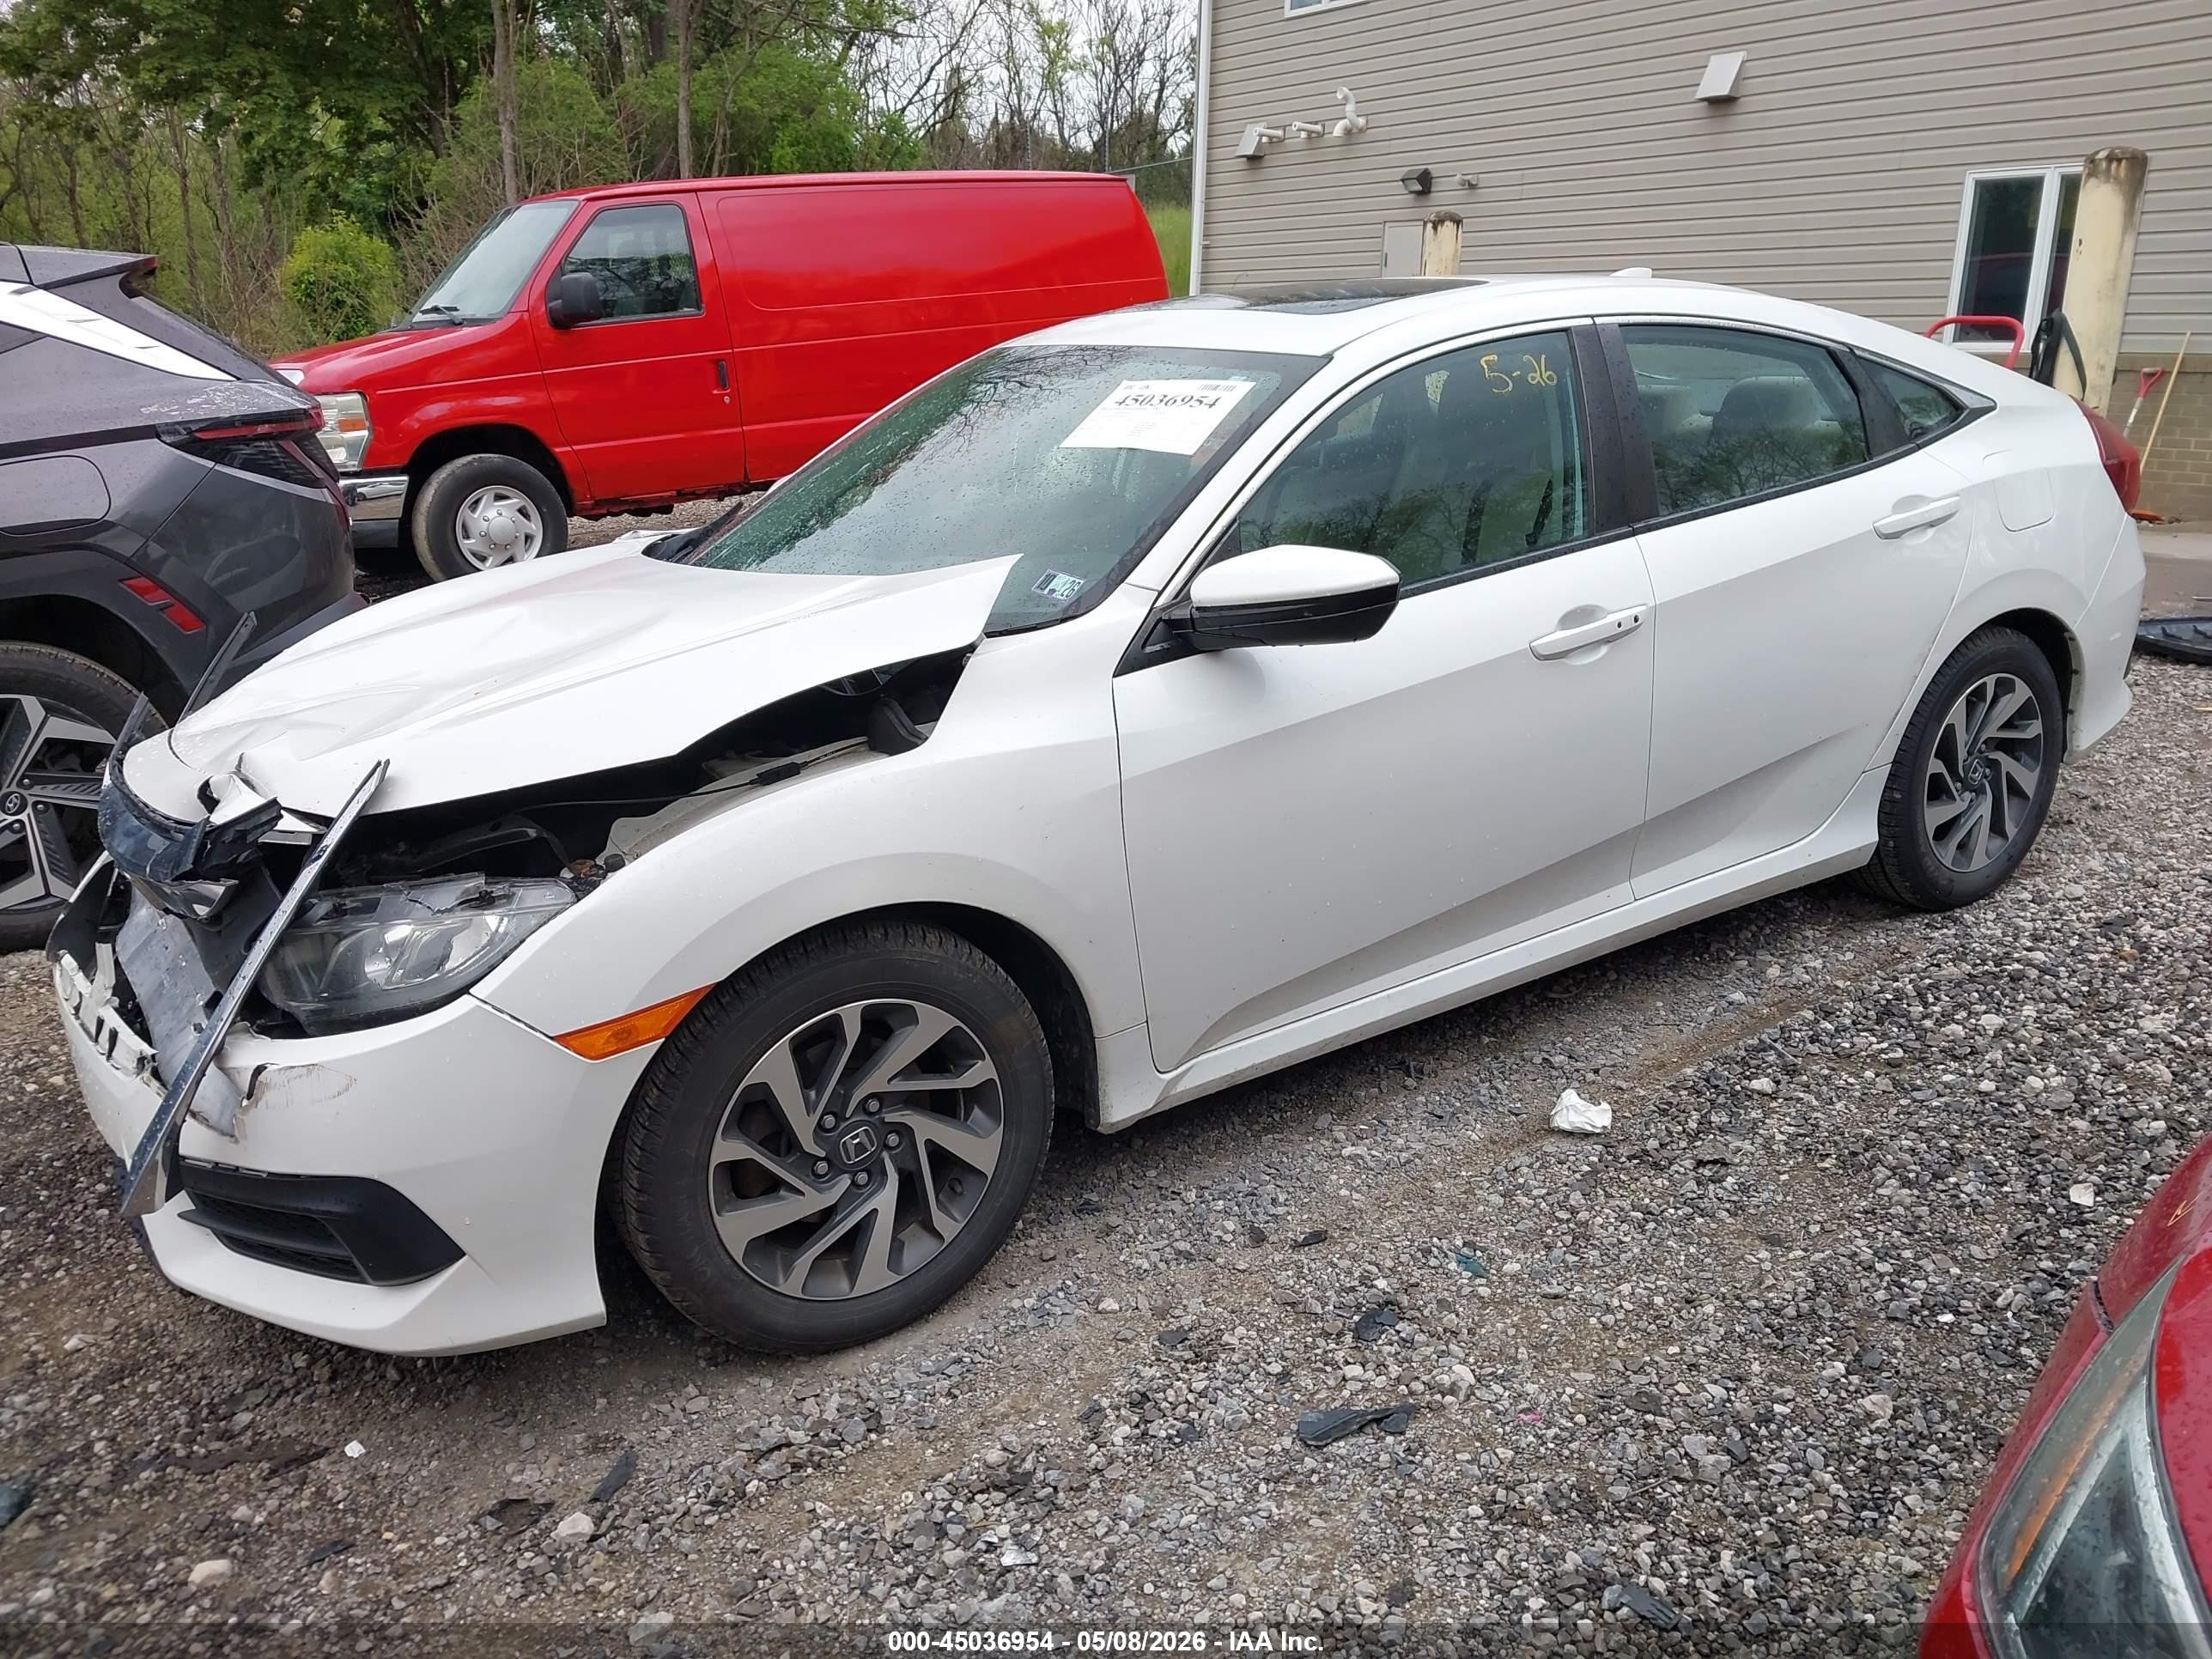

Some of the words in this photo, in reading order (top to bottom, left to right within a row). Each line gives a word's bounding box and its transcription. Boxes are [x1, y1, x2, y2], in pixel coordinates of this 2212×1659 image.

[1480, 353, 1559, 392] 5-26
[1115, 393, 1223, 410] 45036954
[1036, 573, 1058, 591] 10
[1060, 580, 1081, 599] 26
